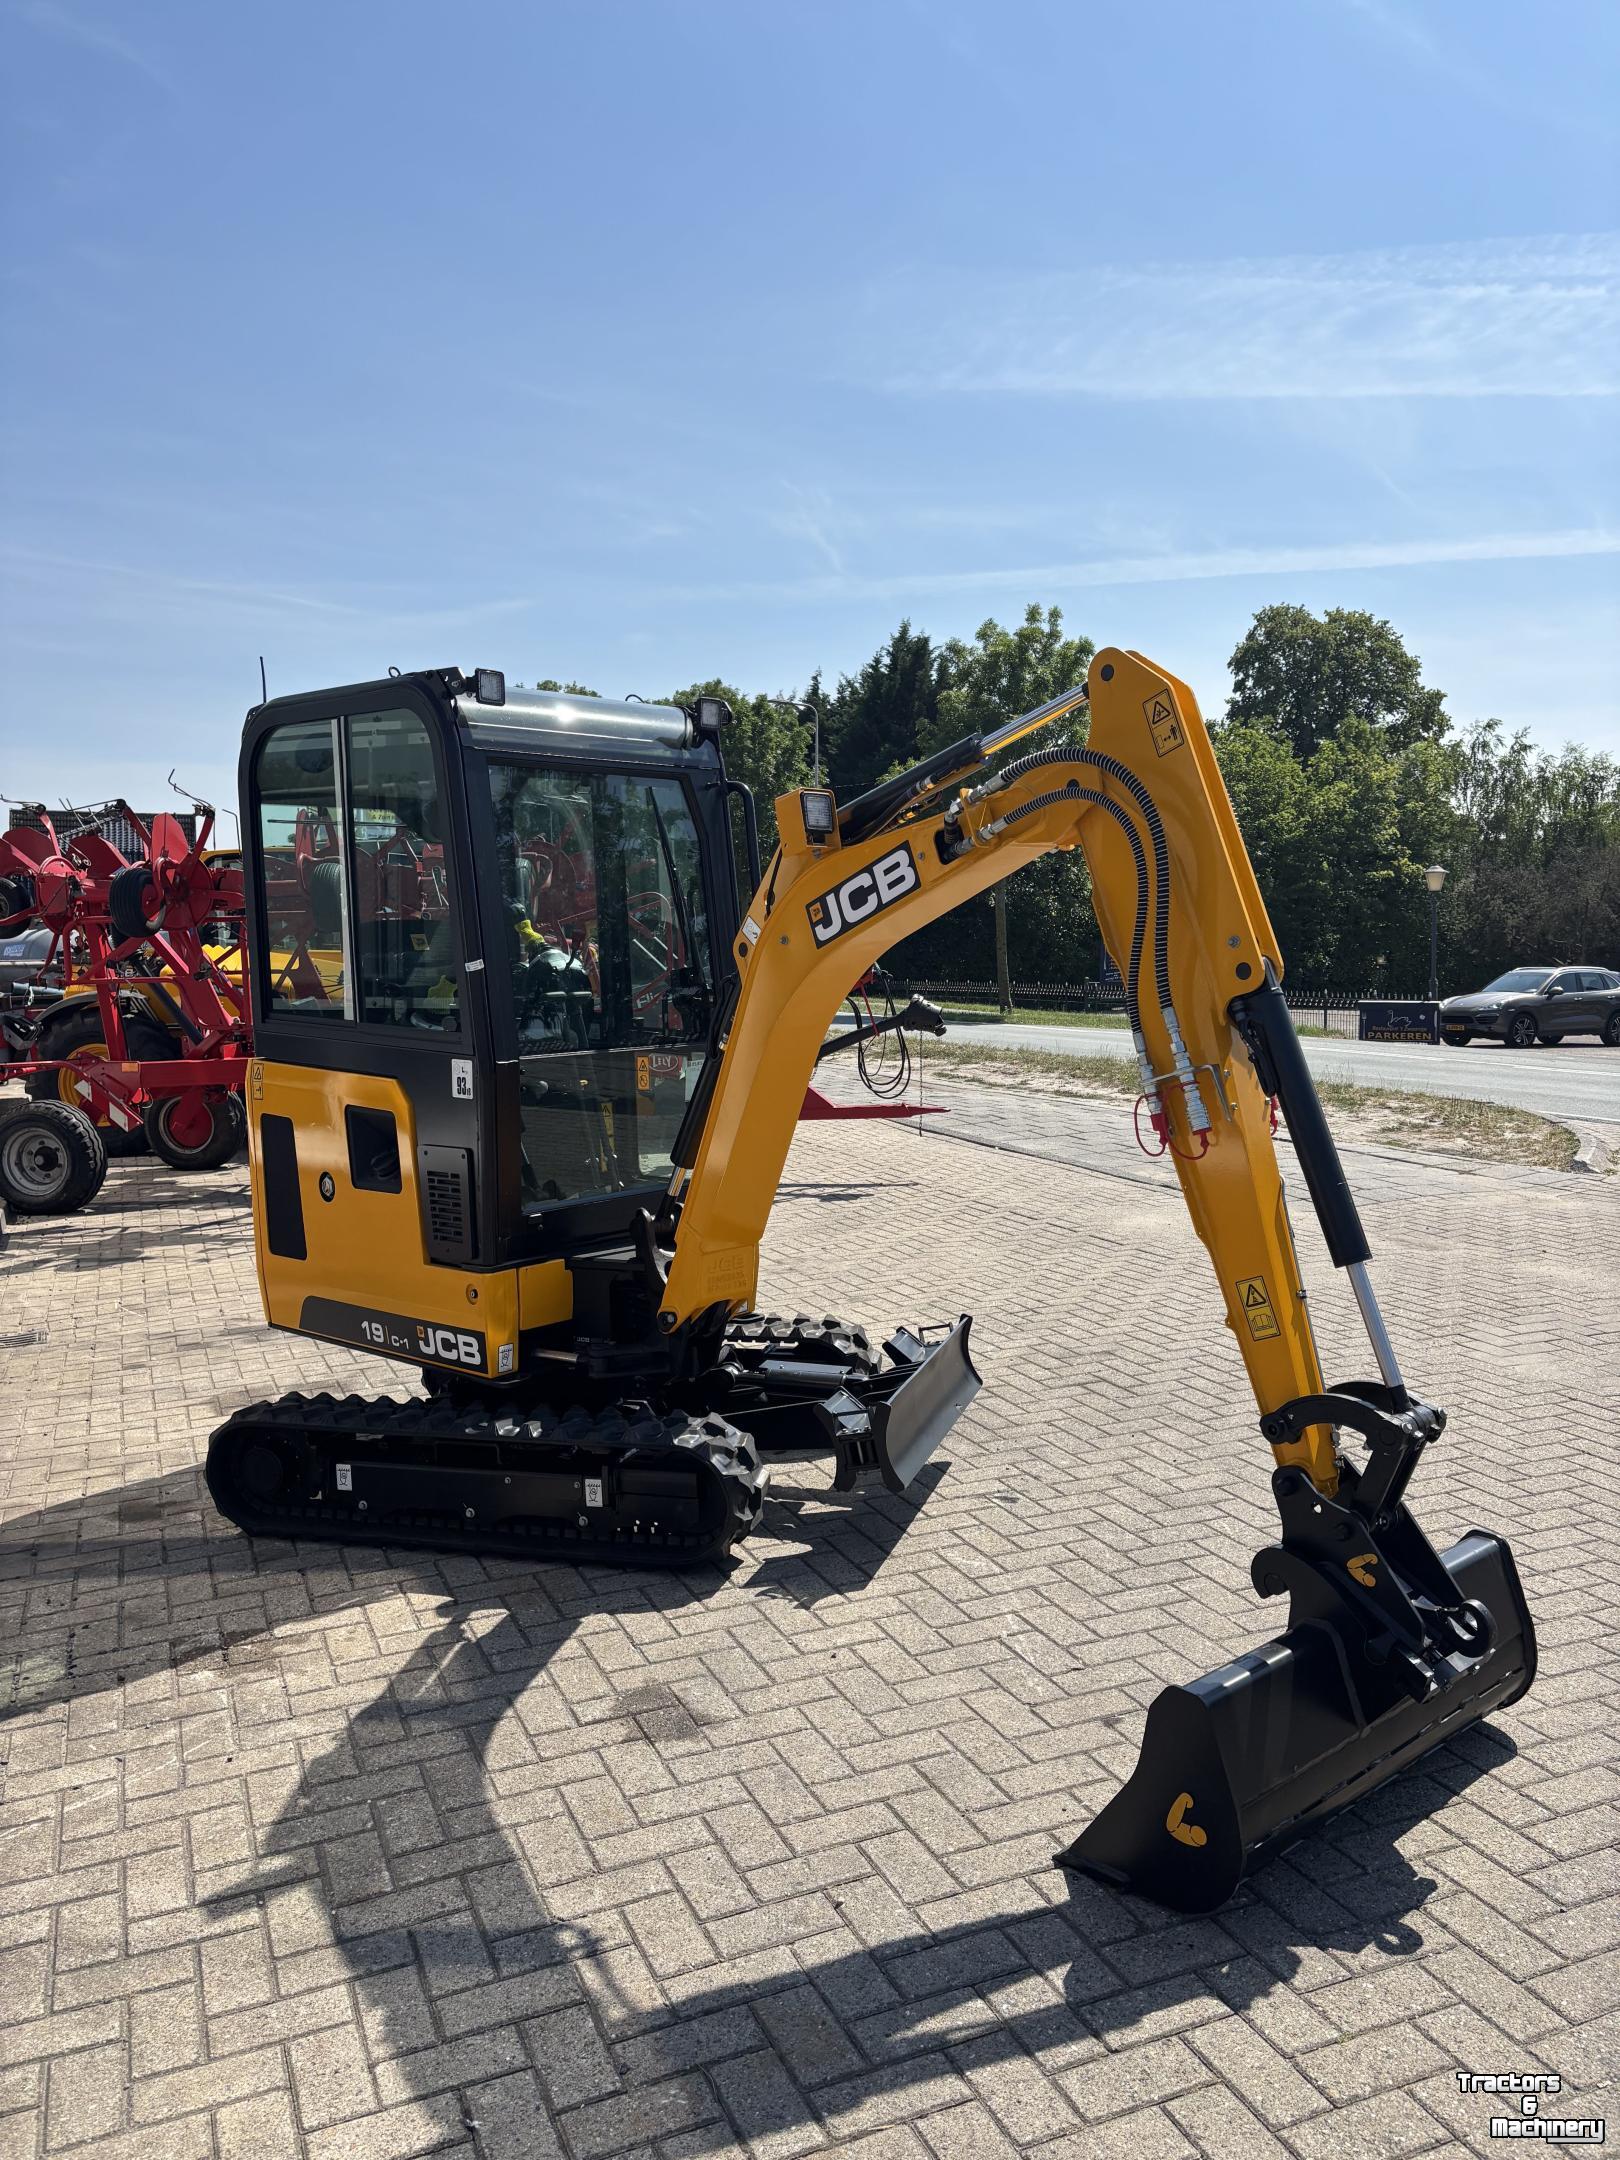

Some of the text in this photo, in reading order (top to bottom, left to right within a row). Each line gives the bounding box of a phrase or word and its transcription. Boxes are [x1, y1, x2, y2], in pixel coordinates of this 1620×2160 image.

[813, 849, 916, 941] JCB
[1367, 1031, 1432, 1040] PARKEREN
[456, 1076, 467, 1096] 93
[361, 1320, 384, 1343] 19
[418, 1327, 481, 1366] JCB
